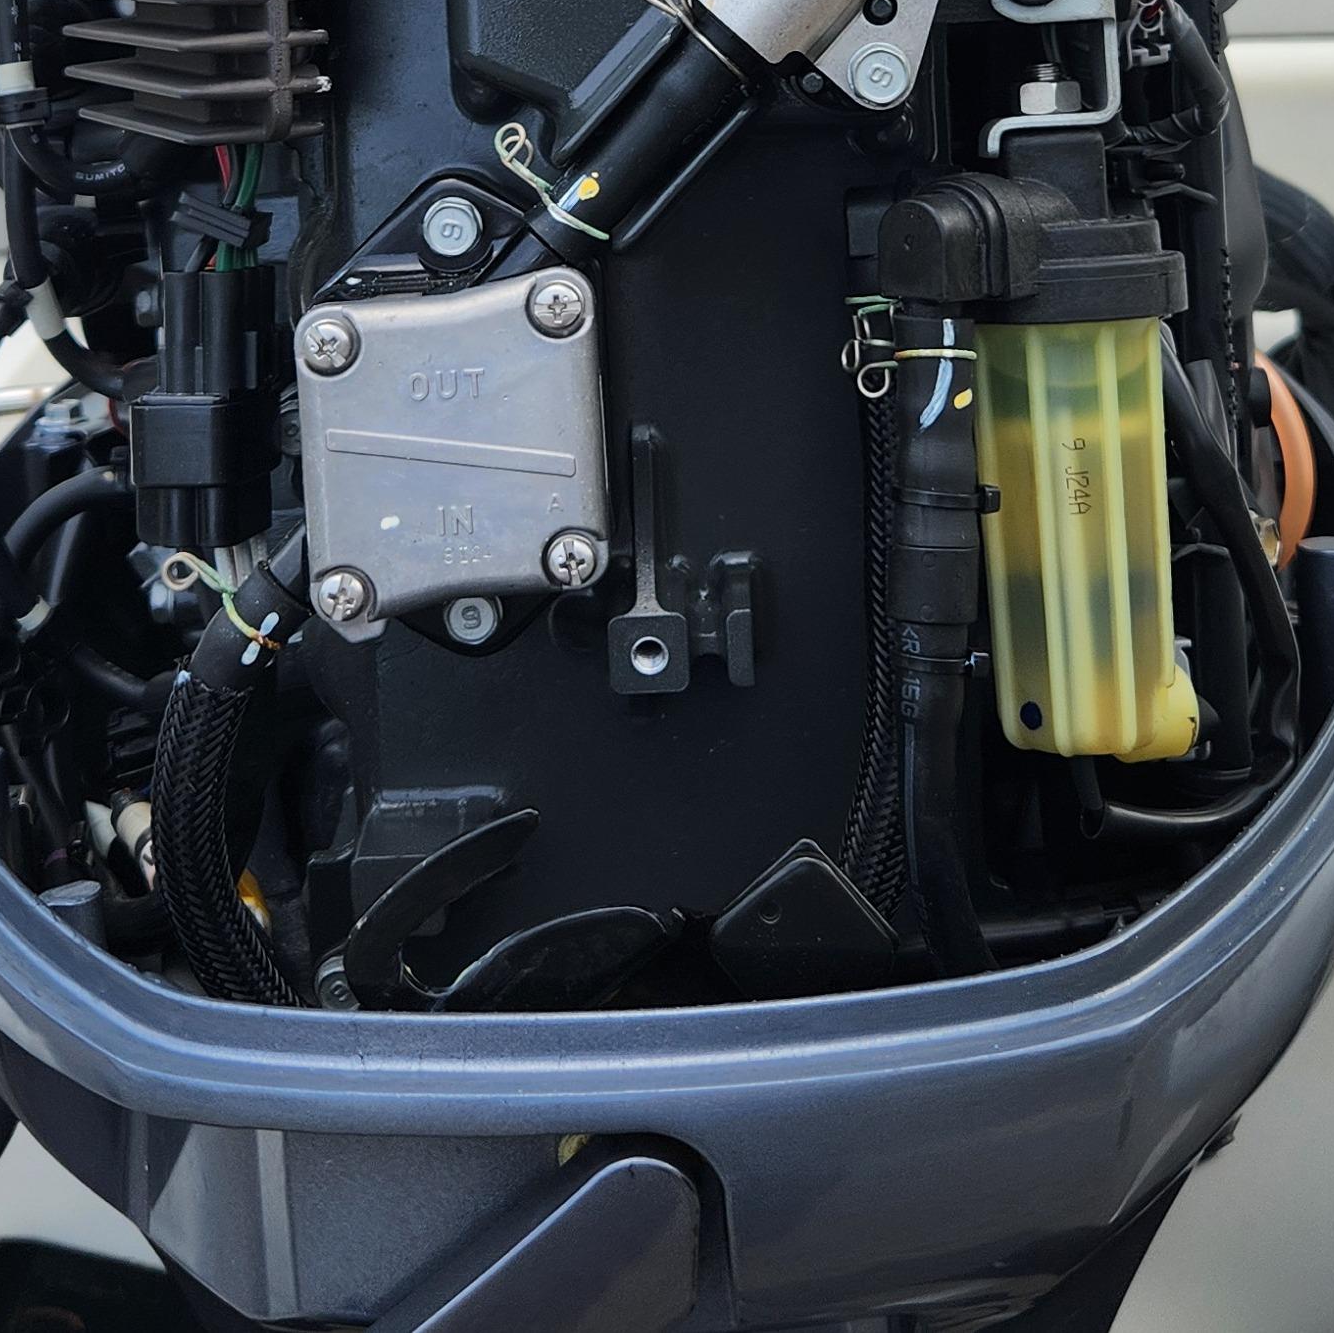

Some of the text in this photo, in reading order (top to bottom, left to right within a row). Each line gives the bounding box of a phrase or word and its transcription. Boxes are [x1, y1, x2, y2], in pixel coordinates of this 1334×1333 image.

[409, 367, 485, 401] OUT
[546, 491, 564, 513] A
[436, 504, 474, 536] IN
